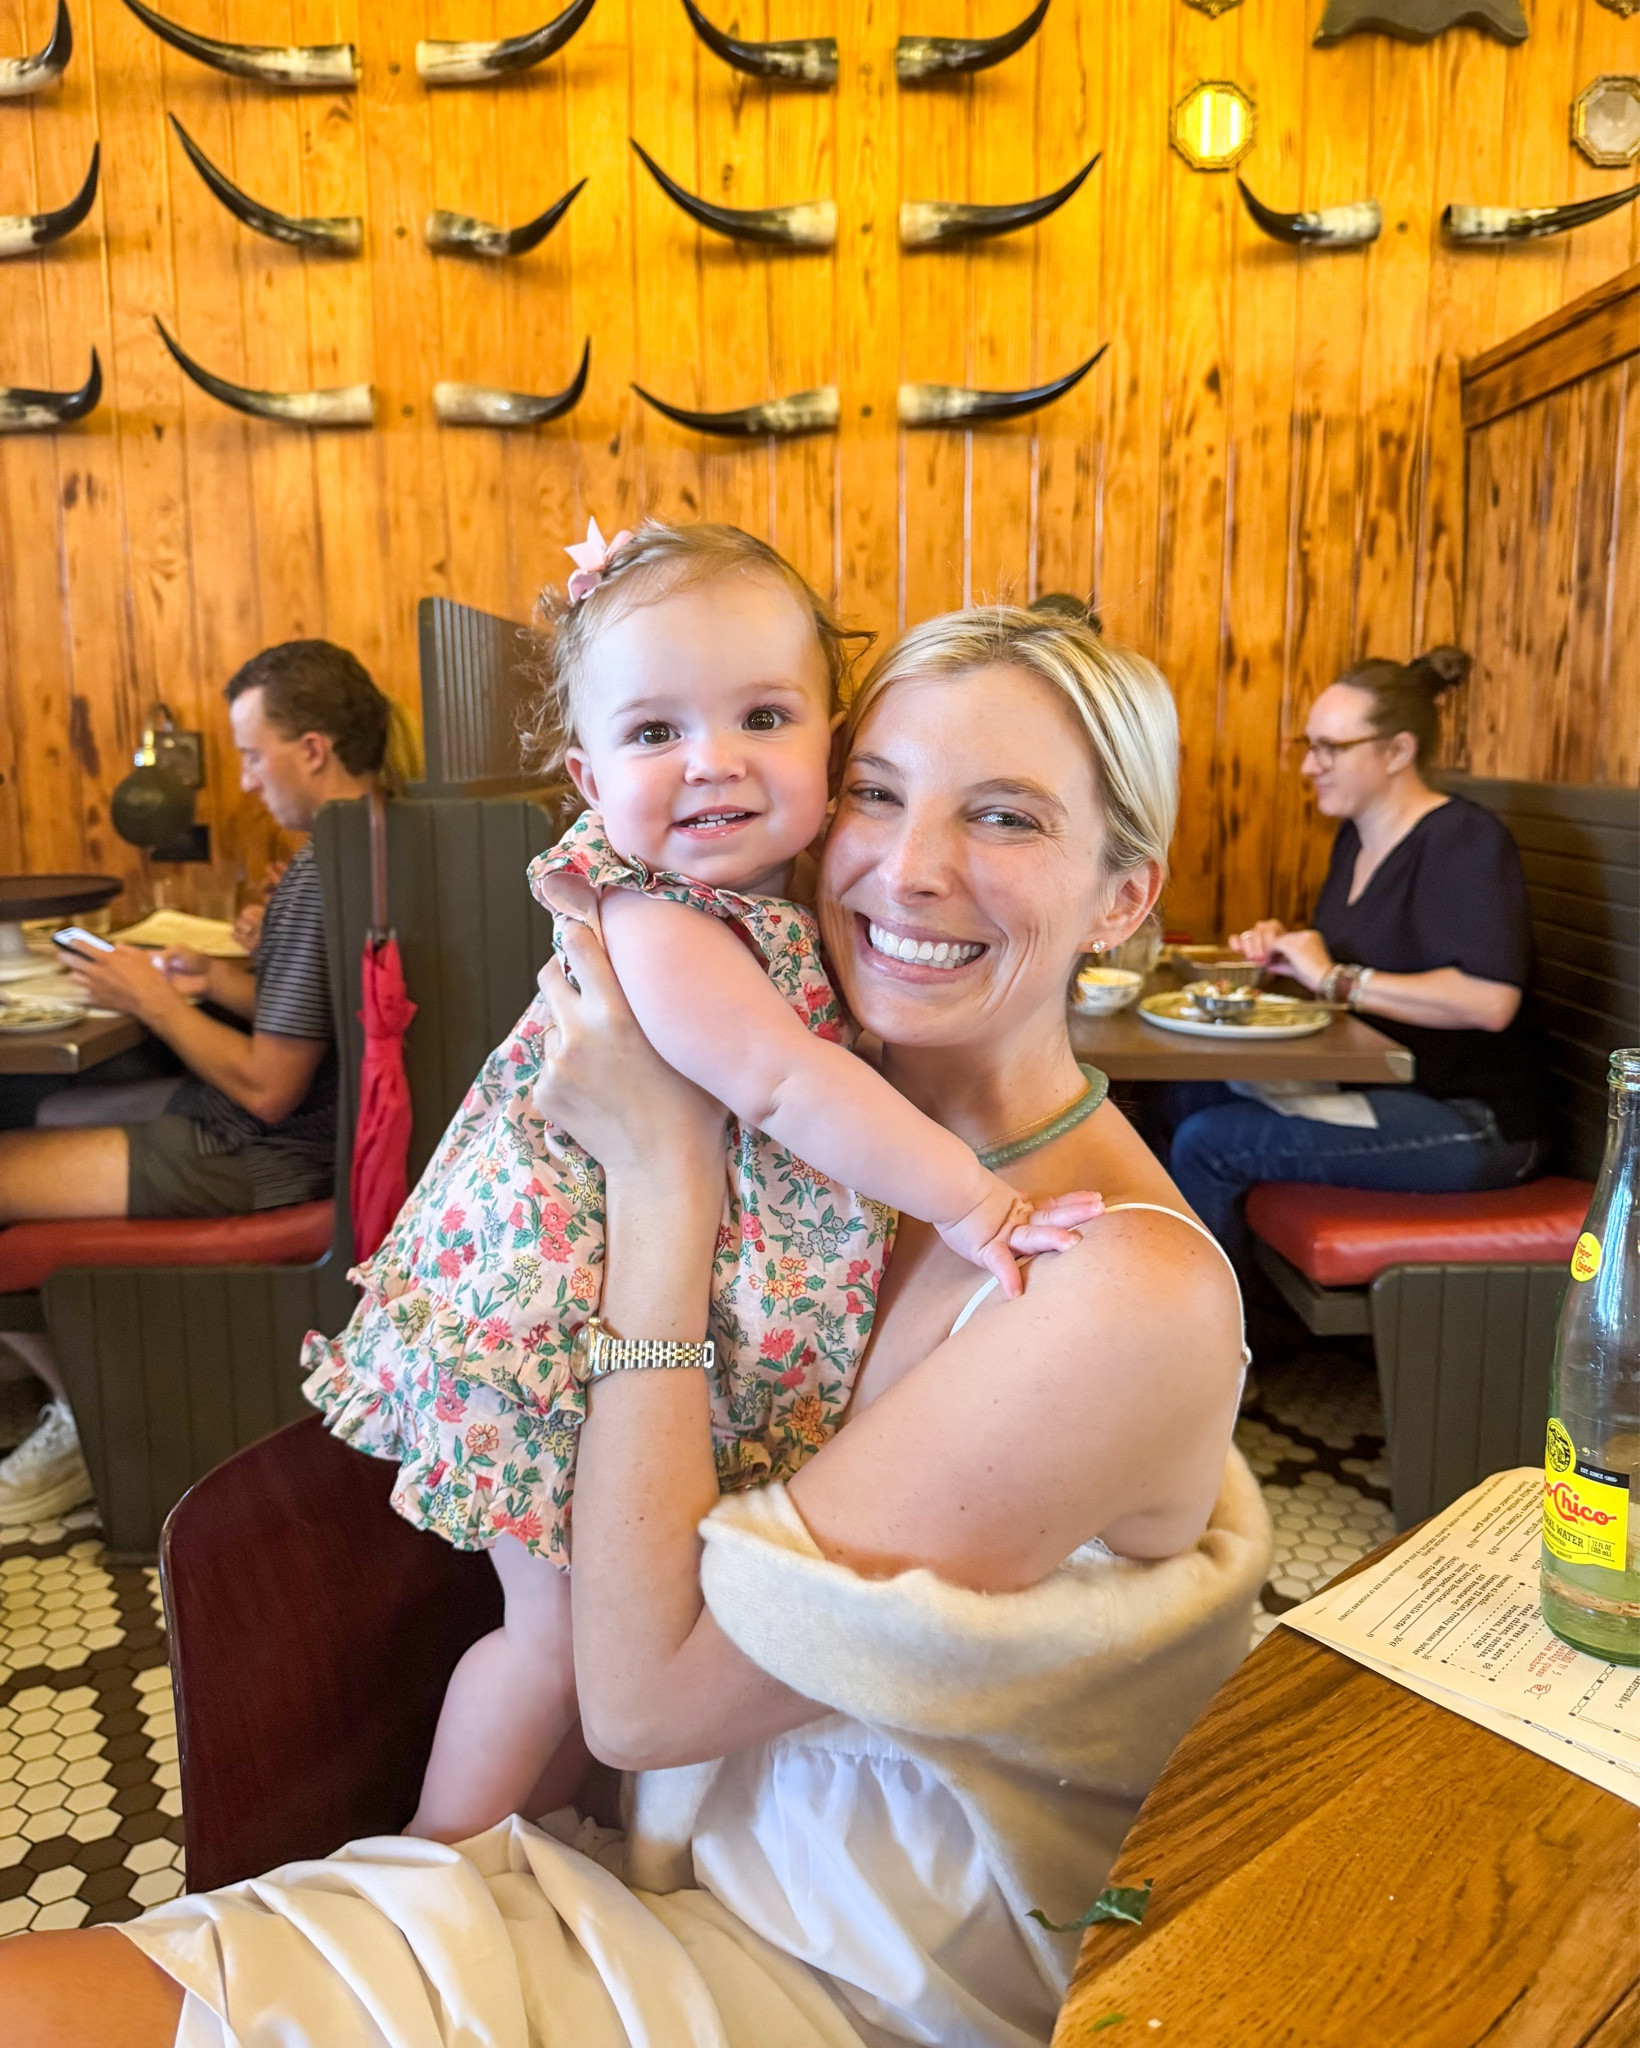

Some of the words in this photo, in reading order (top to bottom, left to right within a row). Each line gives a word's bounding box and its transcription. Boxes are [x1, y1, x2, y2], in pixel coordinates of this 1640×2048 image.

[1576, 1256, 1595, 1274] Chico
[1590, 1470, 1604, 1480] SINCE
[1553, 1482, 1617, 1527] Chico
[1556, 1524, 1584, 1548] WATER
[1493, 1605, 1520, 1627] brochetas,
[1517, 1603, 1534, 1616] steak,
[1498, 1617, 1520, 1635] chicken,
[1512, 1623, 1529, 1638] serves
[1412, 1642, 1429, 1655] butter
[1472, 1632, 1492, 1648] shrimp
[1477, 1636, 1502, 1658] carnitas,
[1491, 1648, 1505, 1660] more
